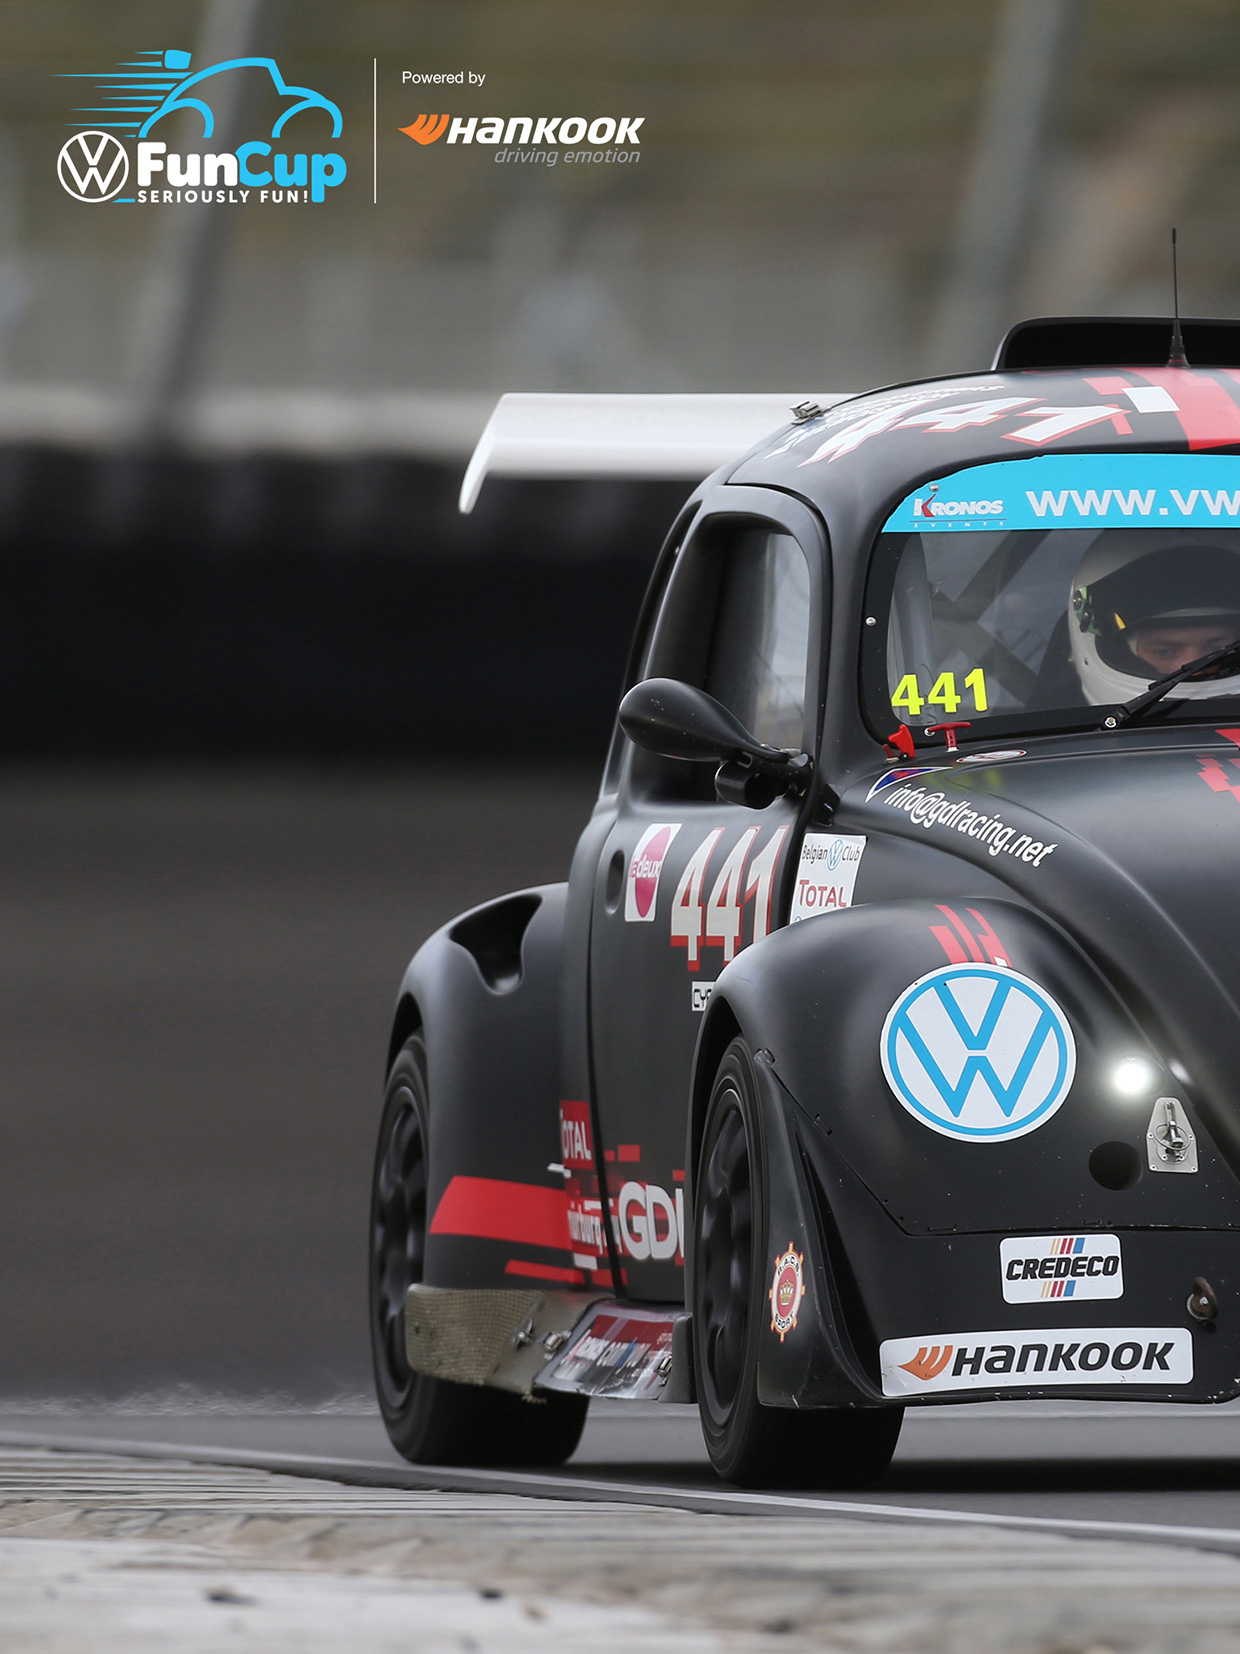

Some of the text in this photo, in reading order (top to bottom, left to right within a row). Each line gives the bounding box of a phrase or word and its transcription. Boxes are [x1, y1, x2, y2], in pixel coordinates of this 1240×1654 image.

[914, 494, 1005, 518] KRONOS
[914, 521, 1006, 529] EVENTS
[892, 668, 989, 716] 441
[884, 783, 1060, 868] info@gdlracing.net
[802, 844, 828, 864] Belgian
[842, 845, 860, 861] Club
[670, 825, 790, 971] 441
[799, 879, 847, 907] TOTAL
[559, 1108, 592, 1160] OTAL
[1006, 1255, 1120, 1282] CREDECO
